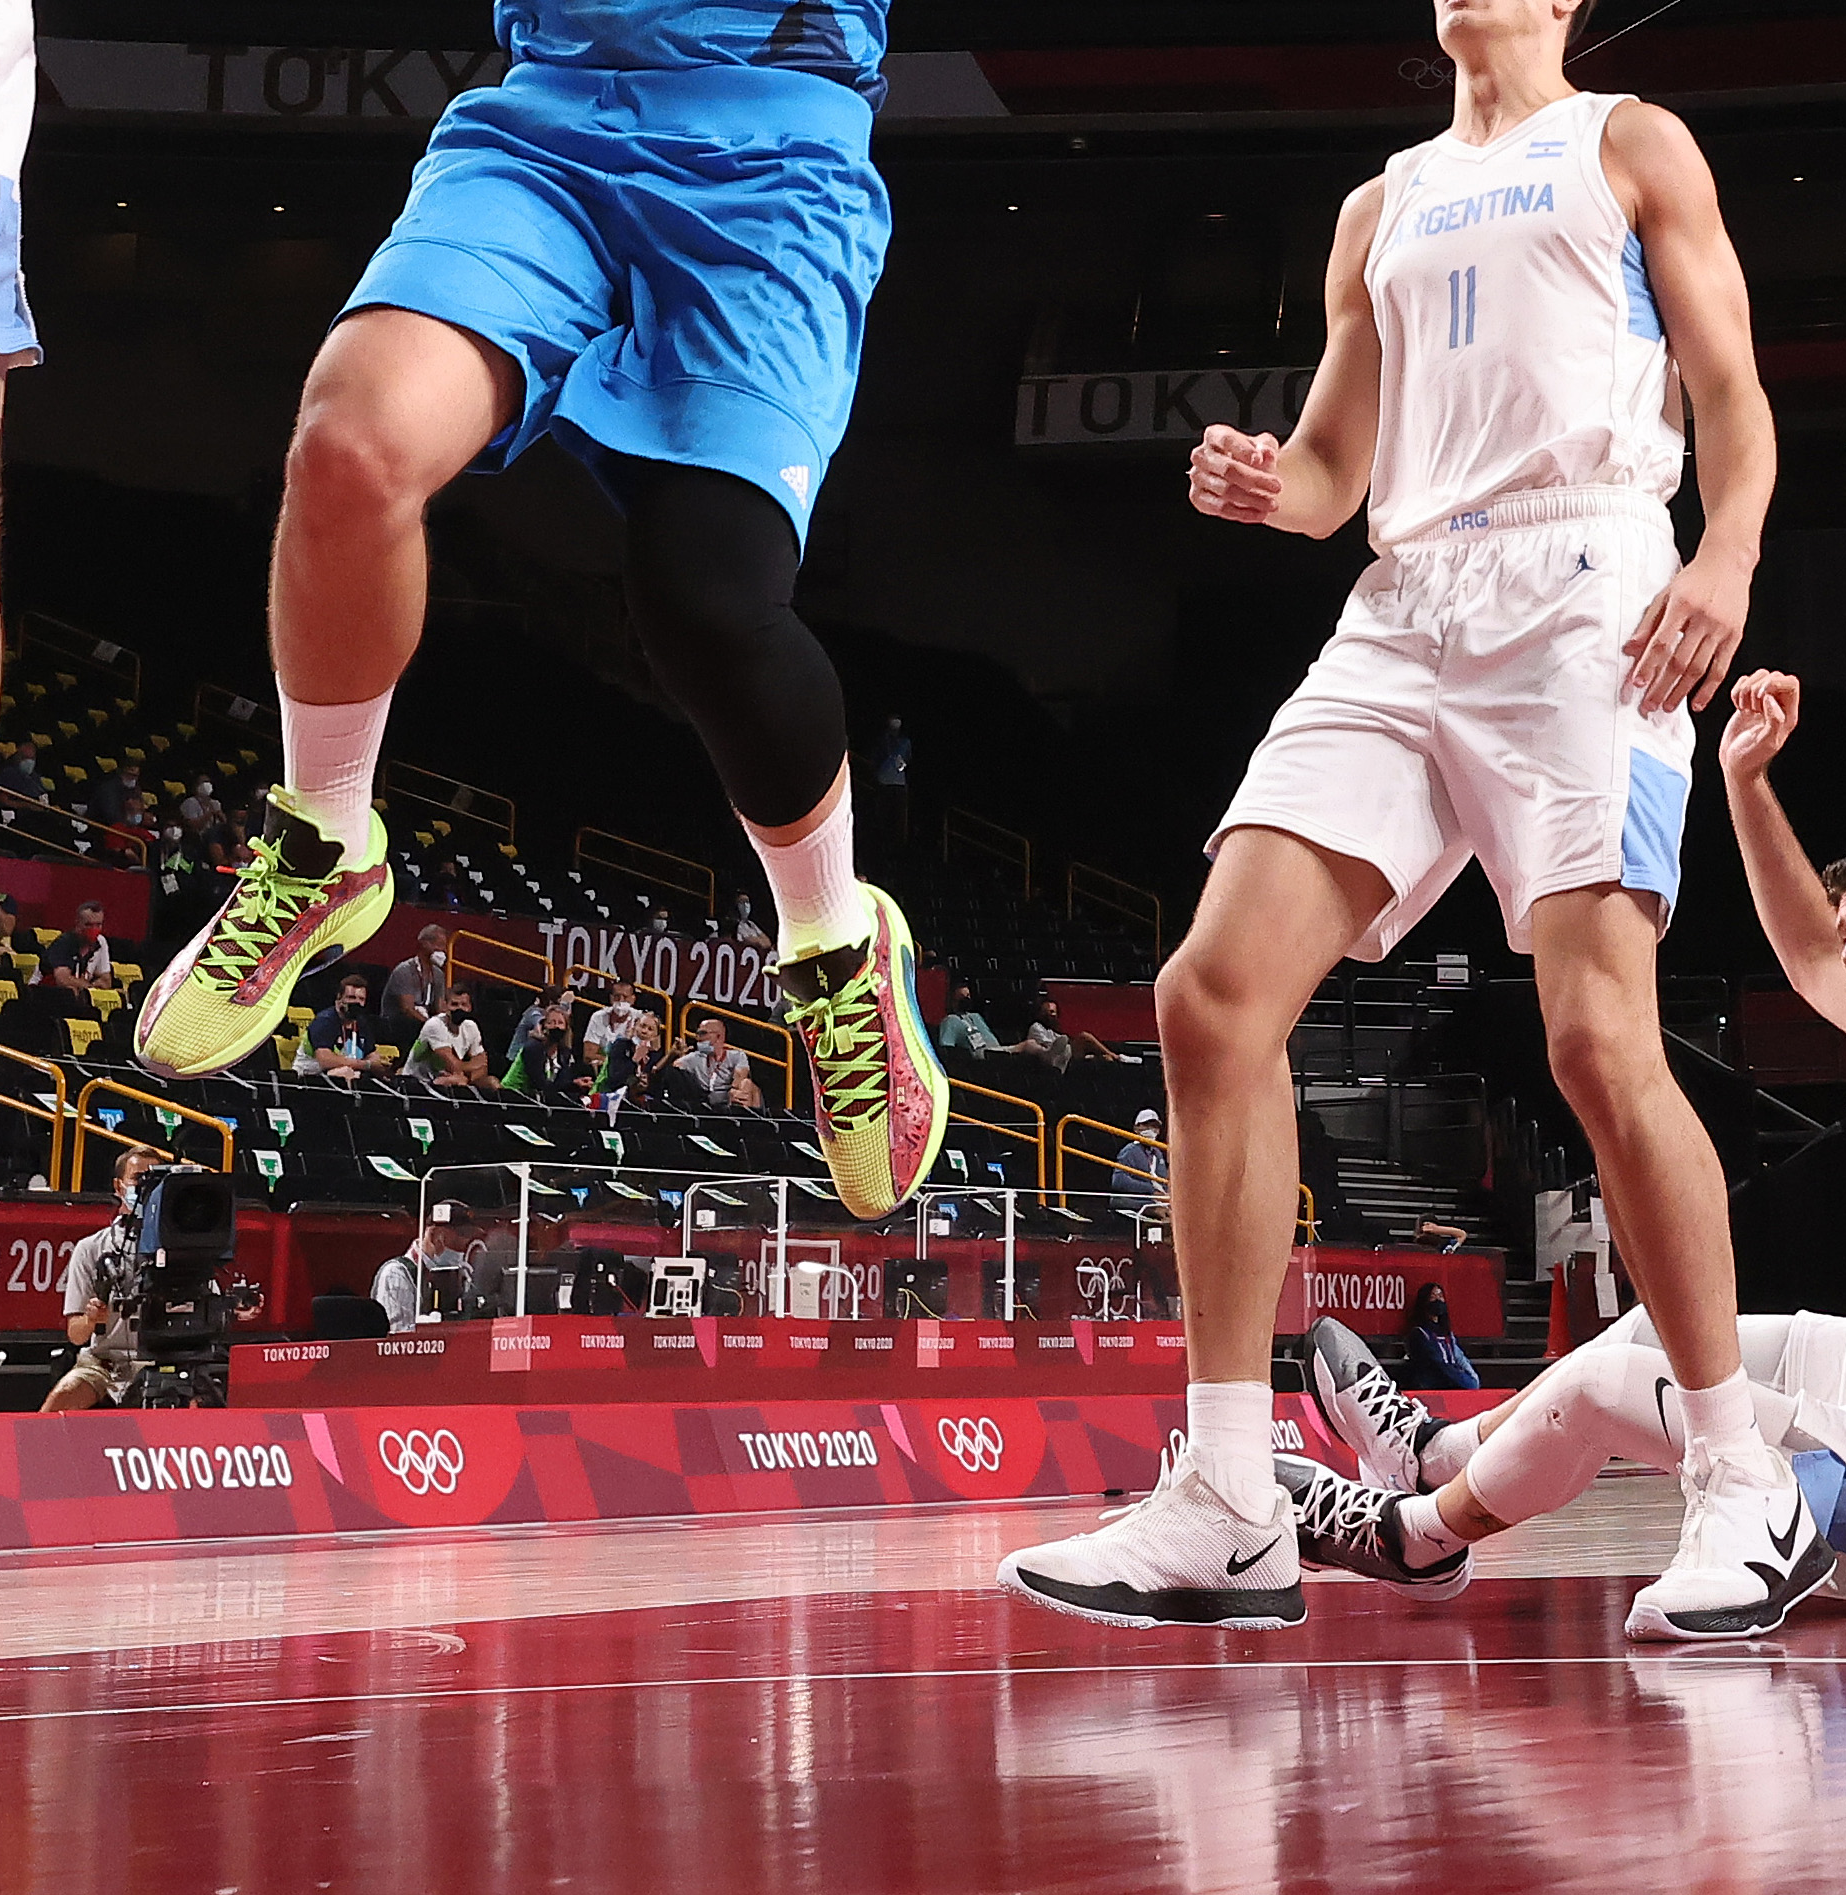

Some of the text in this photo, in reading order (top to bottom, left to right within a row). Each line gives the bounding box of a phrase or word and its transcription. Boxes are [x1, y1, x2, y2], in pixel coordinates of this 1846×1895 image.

[187, 45, 493, 117] TOKY
[1448, 265, 1476, 350] 11
[1449, 510, 1489, 532] ARG
[538, 919, 679, 1001] TOKYO
[1304, 1273, 1406, 1311] TOKYO 2020
[377, 1341, 445, 1357] TOKYO 2020
[492, 1335, 552, 1351] TOKYO 2020
[580, 1335, 625, 1349] TOKYO 2020
[654, 1336, 695, 1349] TOKYO 2020
[723, 1335, 763, 1348] TOKYO 2020
[790, 1336, 829, 1350] TOKYO 2020
[855, 1337, 893, 1350] TOKYO 2020
[918, 1337, 956, 1350] TOKYO 2020
[978, 1336, 1015, 1349] TOKYO 2020
[1038, 1336, 1075, 1349] TOKYO 2020
[1098, 1336, 1134, 1348] TOKYO 2020
[1156, 1336, 1175, 1348] TOKYO
[263, 1346, 330, 1363] TOKYO 2020
[1272, 1420, 1304, 1450] 020
[738, 1430, 878, 1469] TOKYO 2020
[104, 1444, 292, 1492] TOKYO 2020
